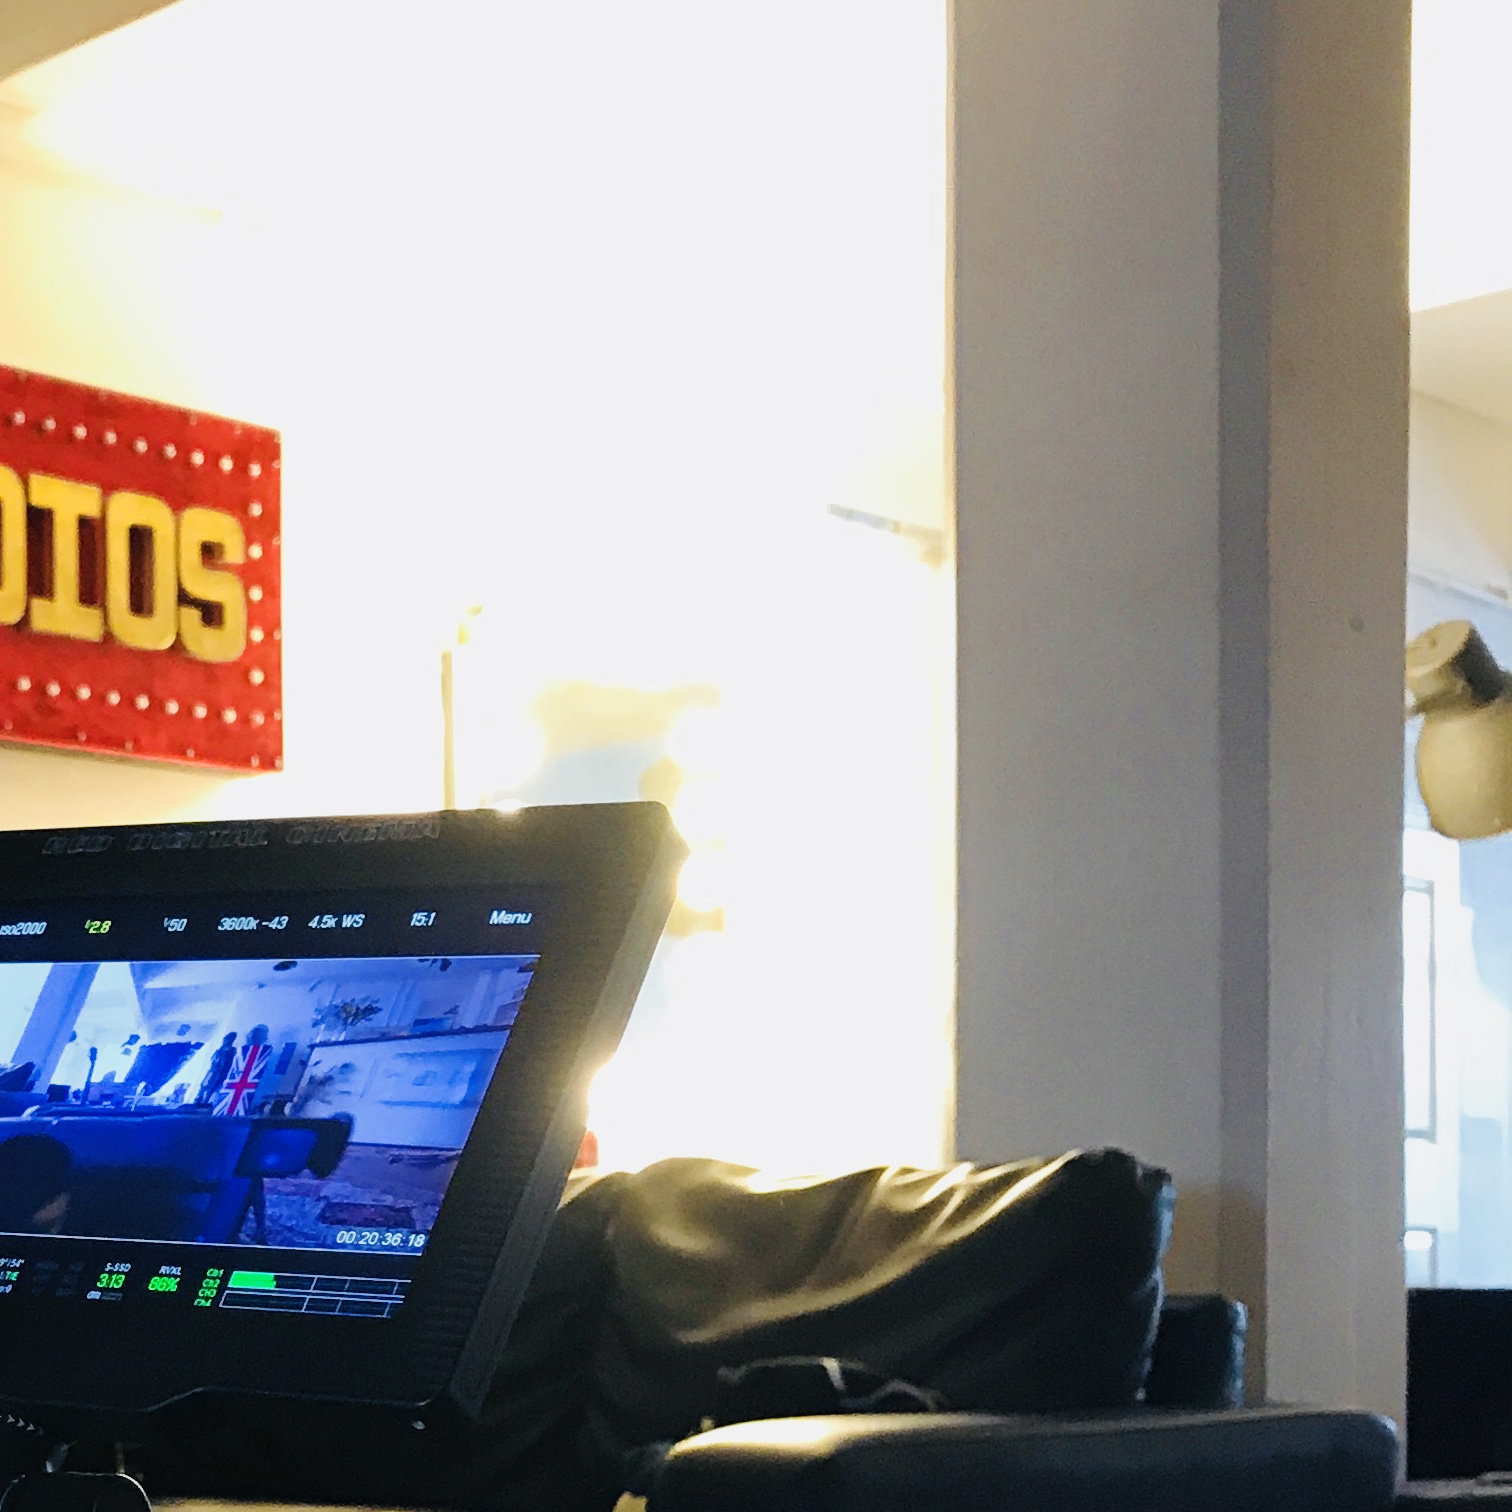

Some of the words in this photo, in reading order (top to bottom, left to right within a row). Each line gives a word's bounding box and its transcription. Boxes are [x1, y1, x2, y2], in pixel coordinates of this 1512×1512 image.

[341, 914, 366, 928] WS
[488, 910, 533, 926] Menu
[335, 1230, 426, 1248] 00:20:36:18
[96, 1273, 126, 1289] 3:13
